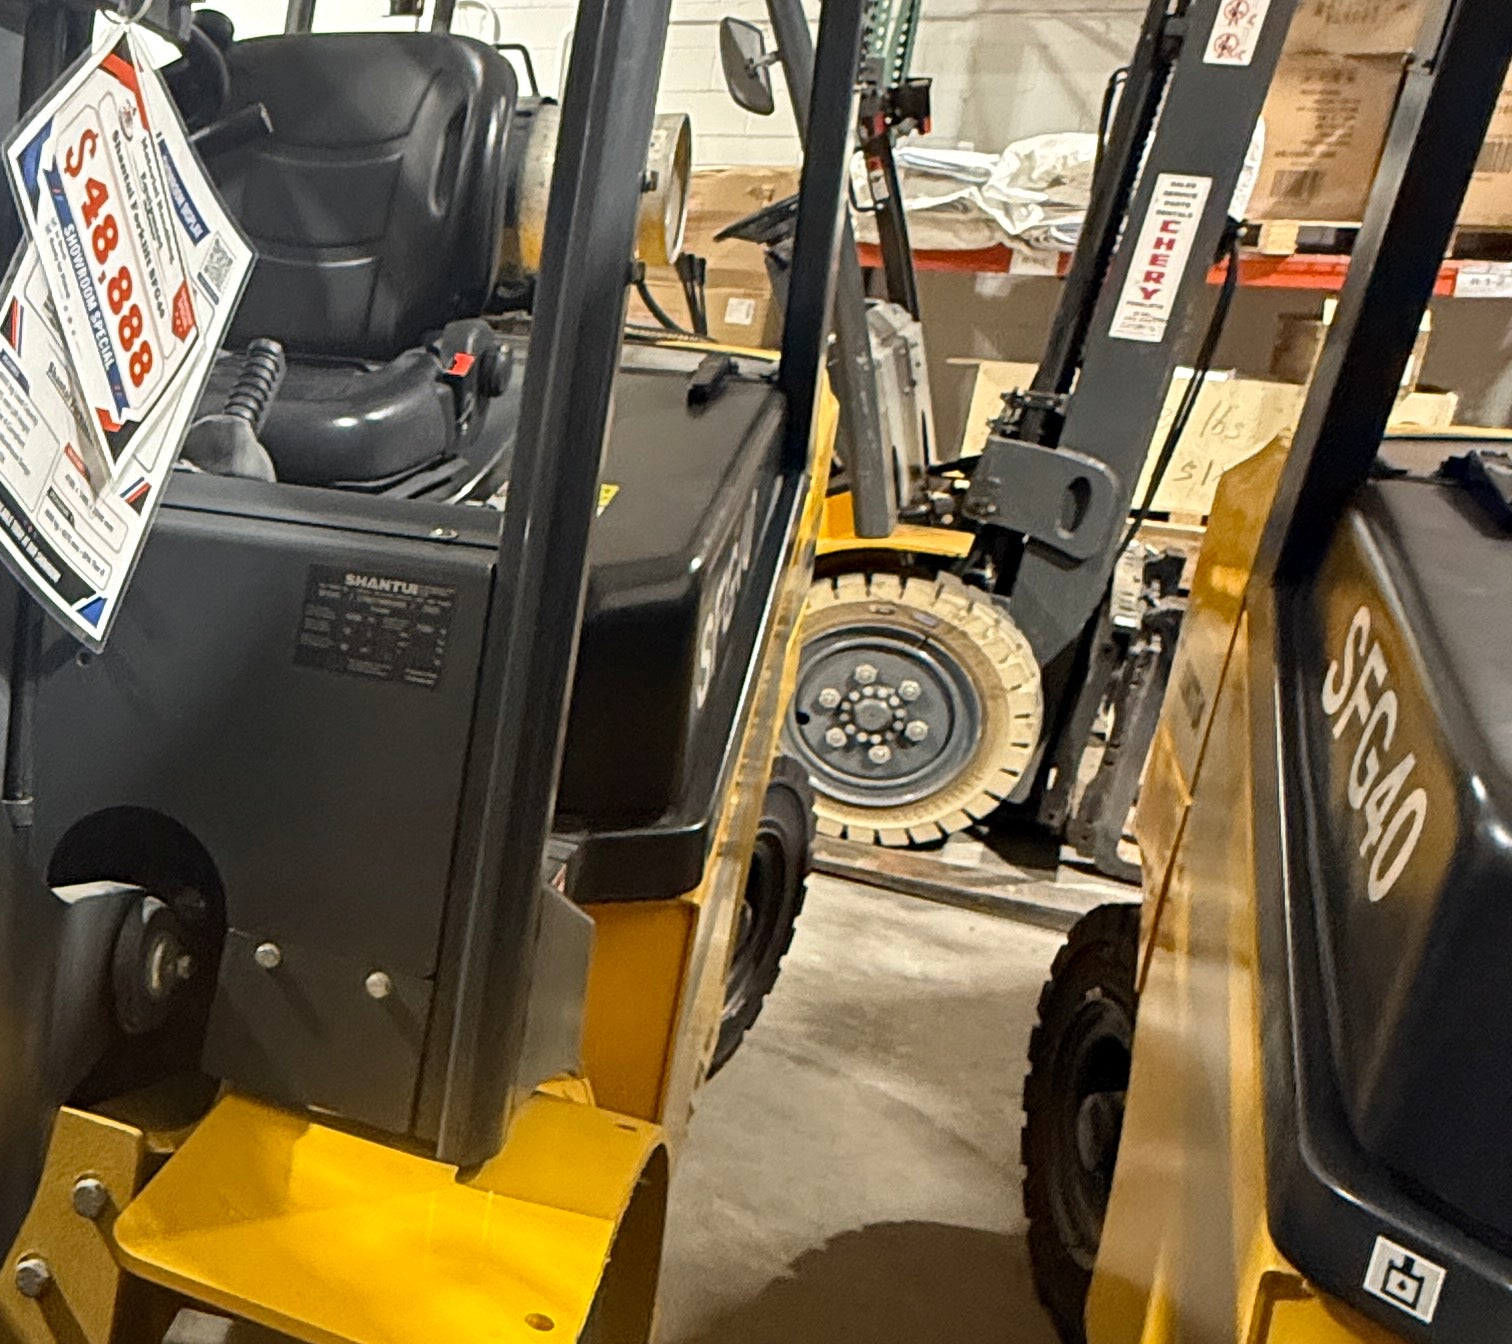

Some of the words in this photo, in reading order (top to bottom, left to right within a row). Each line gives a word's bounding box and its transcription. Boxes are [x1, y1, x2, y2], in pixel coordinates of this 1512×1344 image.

[63, 222, 97, 313] SHOWROOM
[90, 309, 114, 371] SPECIAL
[1139, 219, 1182, 300] CHERY
[346, 573, 418, 595] SHANTUI
[1322, 605, 1428, 902] SFG40
